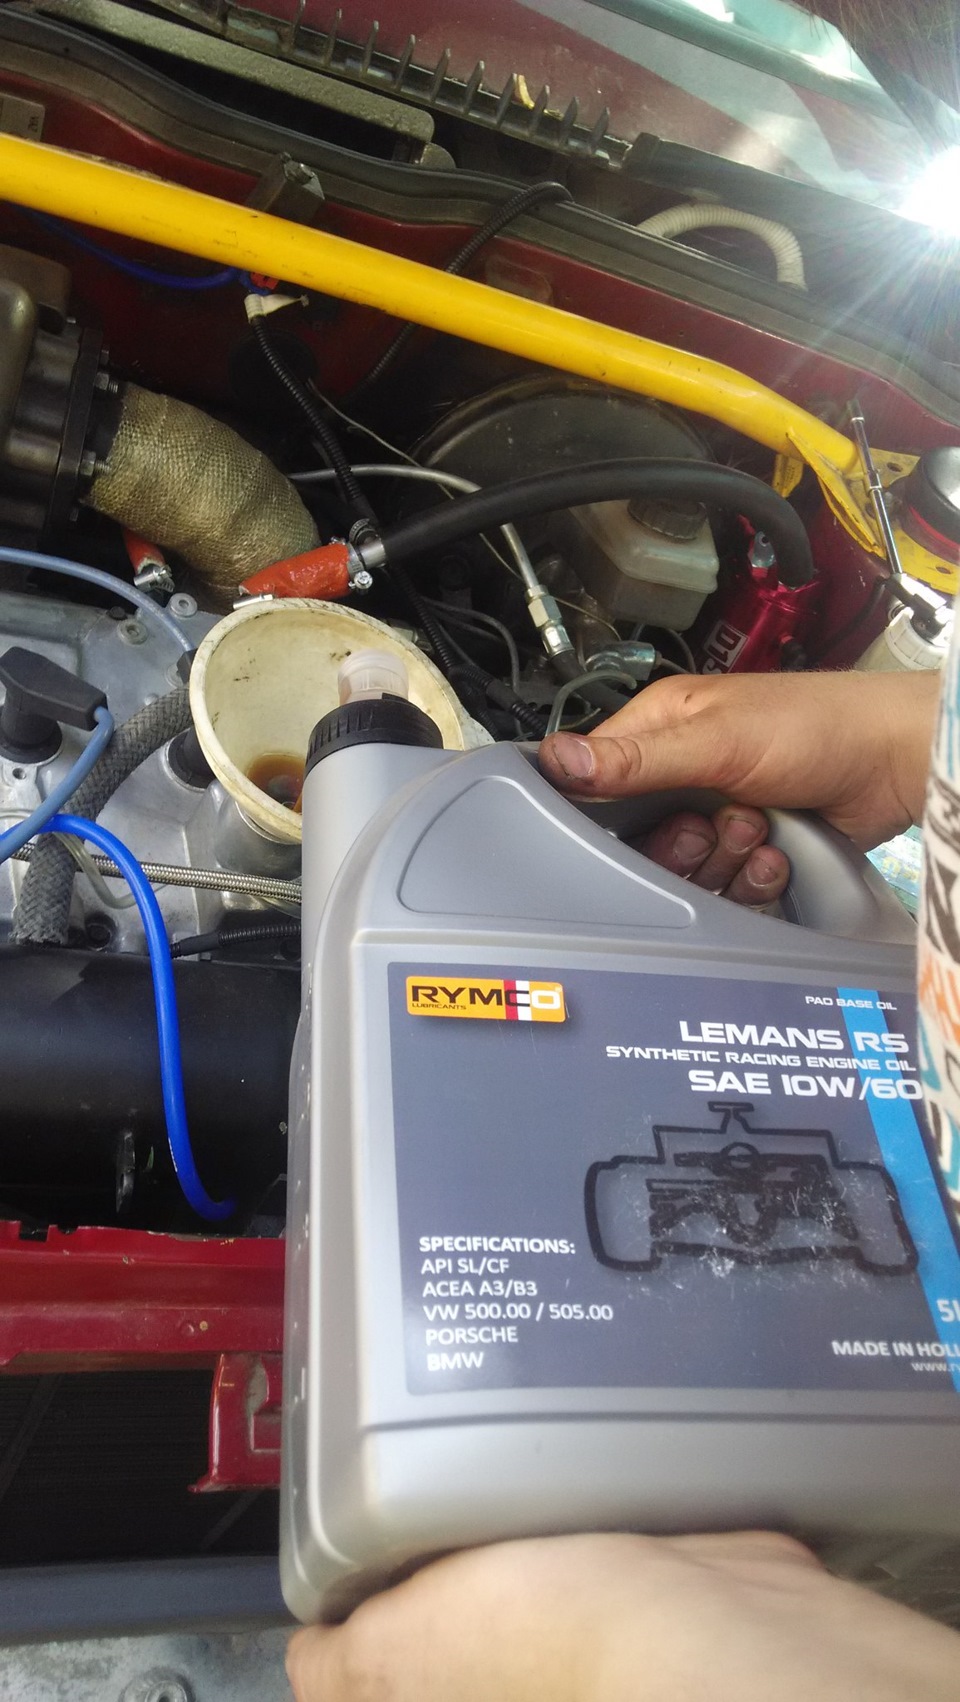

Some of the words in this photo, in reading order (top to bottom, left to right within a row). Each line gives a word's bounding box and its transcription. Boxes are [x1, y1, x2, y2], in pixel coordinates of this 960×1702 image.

[411, 985, 561, 1010] RYMCO
[411, 1002, 467, 1010] LUBRICANTS
[805, 995, 833, 1006] PAO
[836, 998, 873, 1009] BASE
[876, 1000, 897, 1010] OIL
[679, 1020, 844, 1050] LEMANS
[853, 1031, 909, 1053] RS
[606, 1045, 720, 1062] SYNTHETIC
[725, 1052, 801, 1067] RACING
[806, 1056, 880, 1070] ENGINE
[885, 1059, 916, 1071] OIL
[688, 1069, 772, 1095] SAE
[419, 1236, 576, 1254] SPECIFICATIONS:
[421, 1258, 452, 1275] API
[457, 1257, 510, 1276] SL/CF
[422, 1280, 475, 1297] ACEA
[479, 1279, 538, 1298] A3/B3
[423, 1304, 460, 1321] VW
[464, 1303, 531, 1319] 500.00
[549, 1304, 614, 1320] 505.00
[425, 1326, 519, 1345] PORSCHE
[831, 1340, 890, 1356] MADE
[892, 1341, 914, 1357] IN
[427, 1352, 484, 1371] BMW
